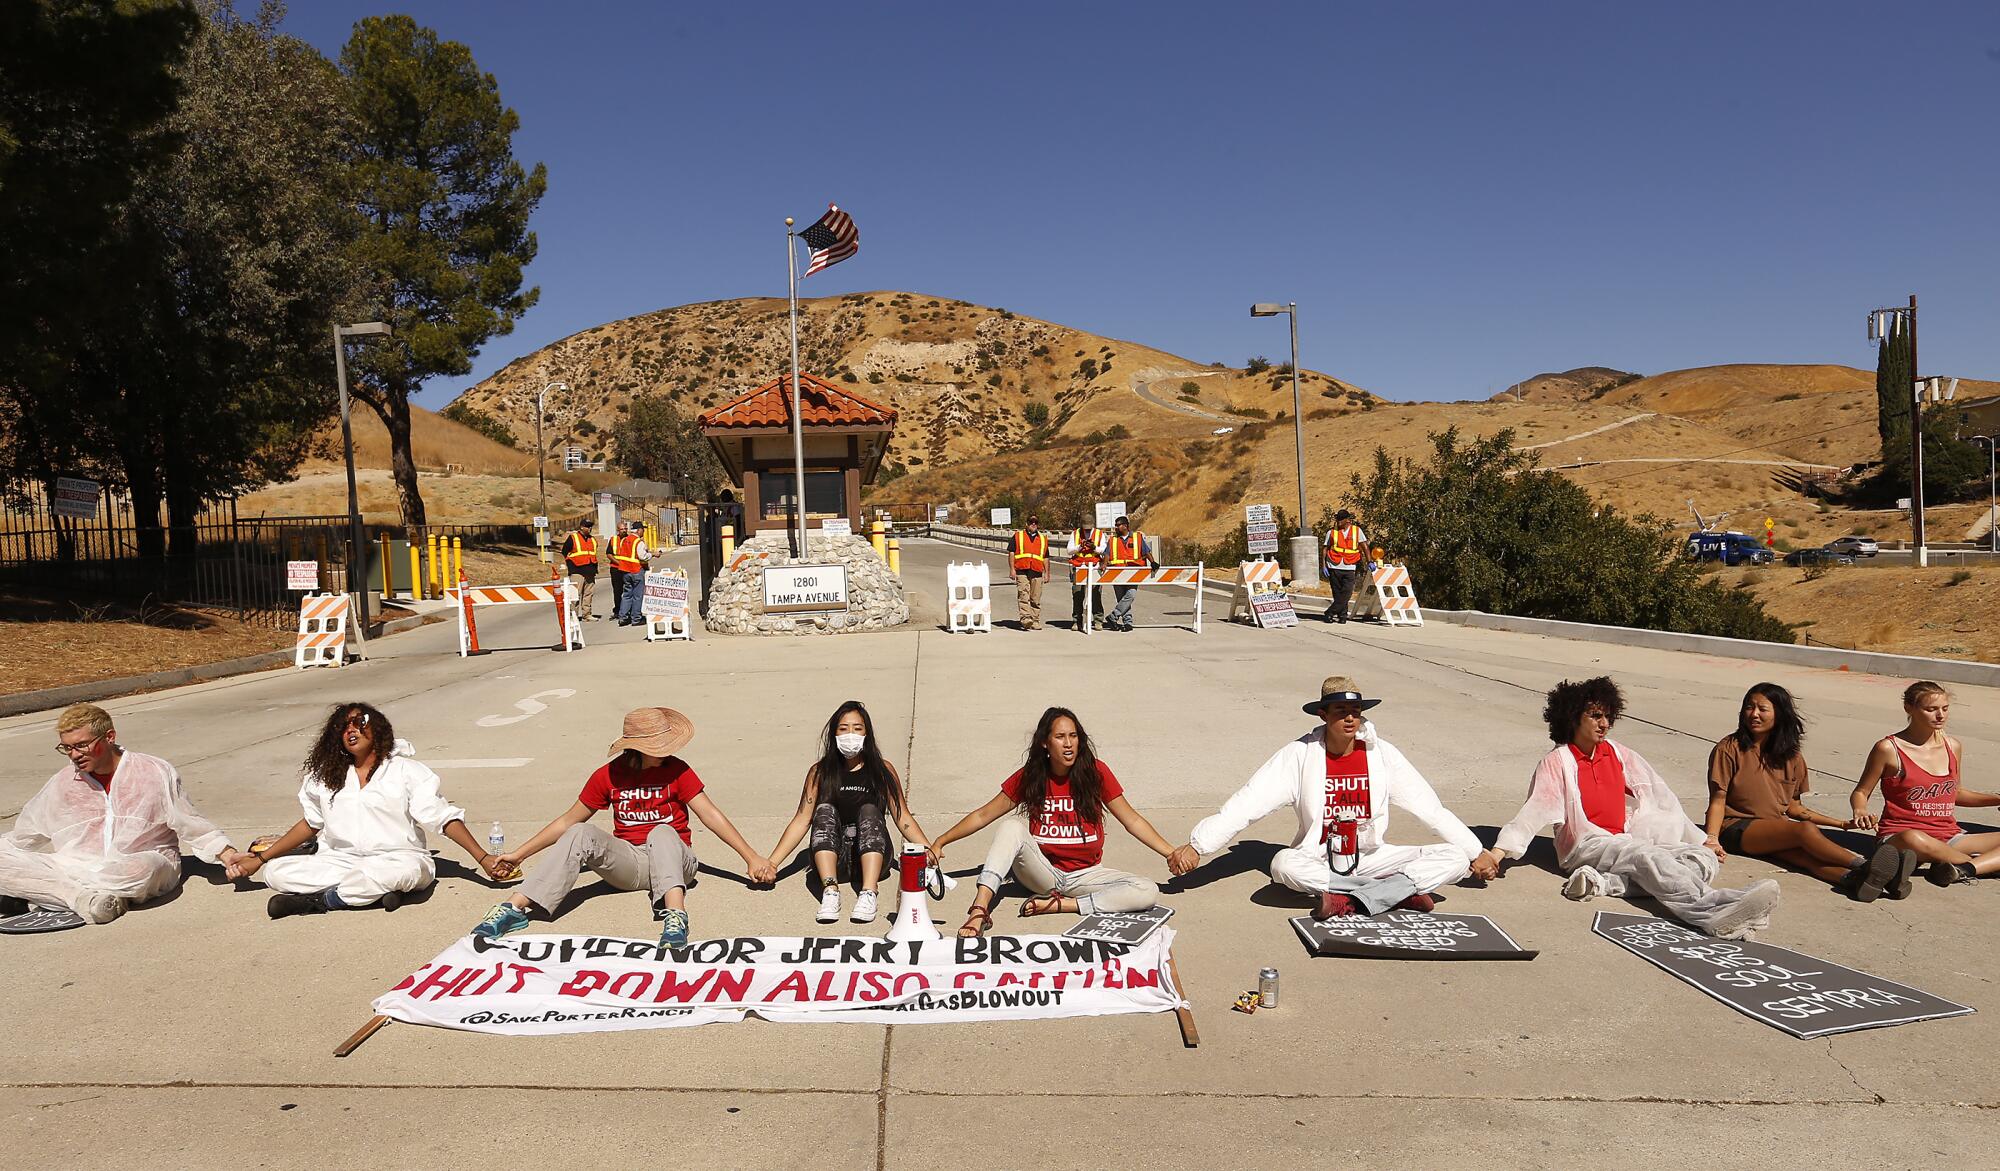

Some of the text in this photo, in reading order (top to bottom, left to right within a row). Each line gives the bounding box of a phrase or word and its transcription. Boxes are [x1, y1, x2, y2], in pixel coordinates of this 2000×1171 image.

[1703, 543, 1727, 551] LIVE
[647, 576, 687, 588] PRIVATE PROPERTY
[793, 577, 818, 588] 12801
[646, 587, 686, 600] NO TRESPASSING
[772, 592, 840, 605] TAMPA AVENUE
[1325, 778, 1369, 792] SHUT.
[619, 787, 663, 799] SHUT.
[1326, 794, 1337, 804] T.
[1044, 799, 1074, 812] SHU
[618, 810, 665, 821] DOWN.
[1387, 914, 1437, 922] LIES
[1401, 921, 1469, 929] VICTIM
[1073, 928, 1124, 939] HELL
[1328, 929, 1359, 937] OF
[1356, 936, 1457, 946] GREED
[955, 935, 1131, 964] BROWN
[1715, 964, 1824, 988] SOUL
[558, 968, 756, 1003] DOWN
[761, 970, 930, 1002] ALISO
[1777, 981, 1817, 992] TO
[1762, 987, 1921, 1019] SEMPRA
